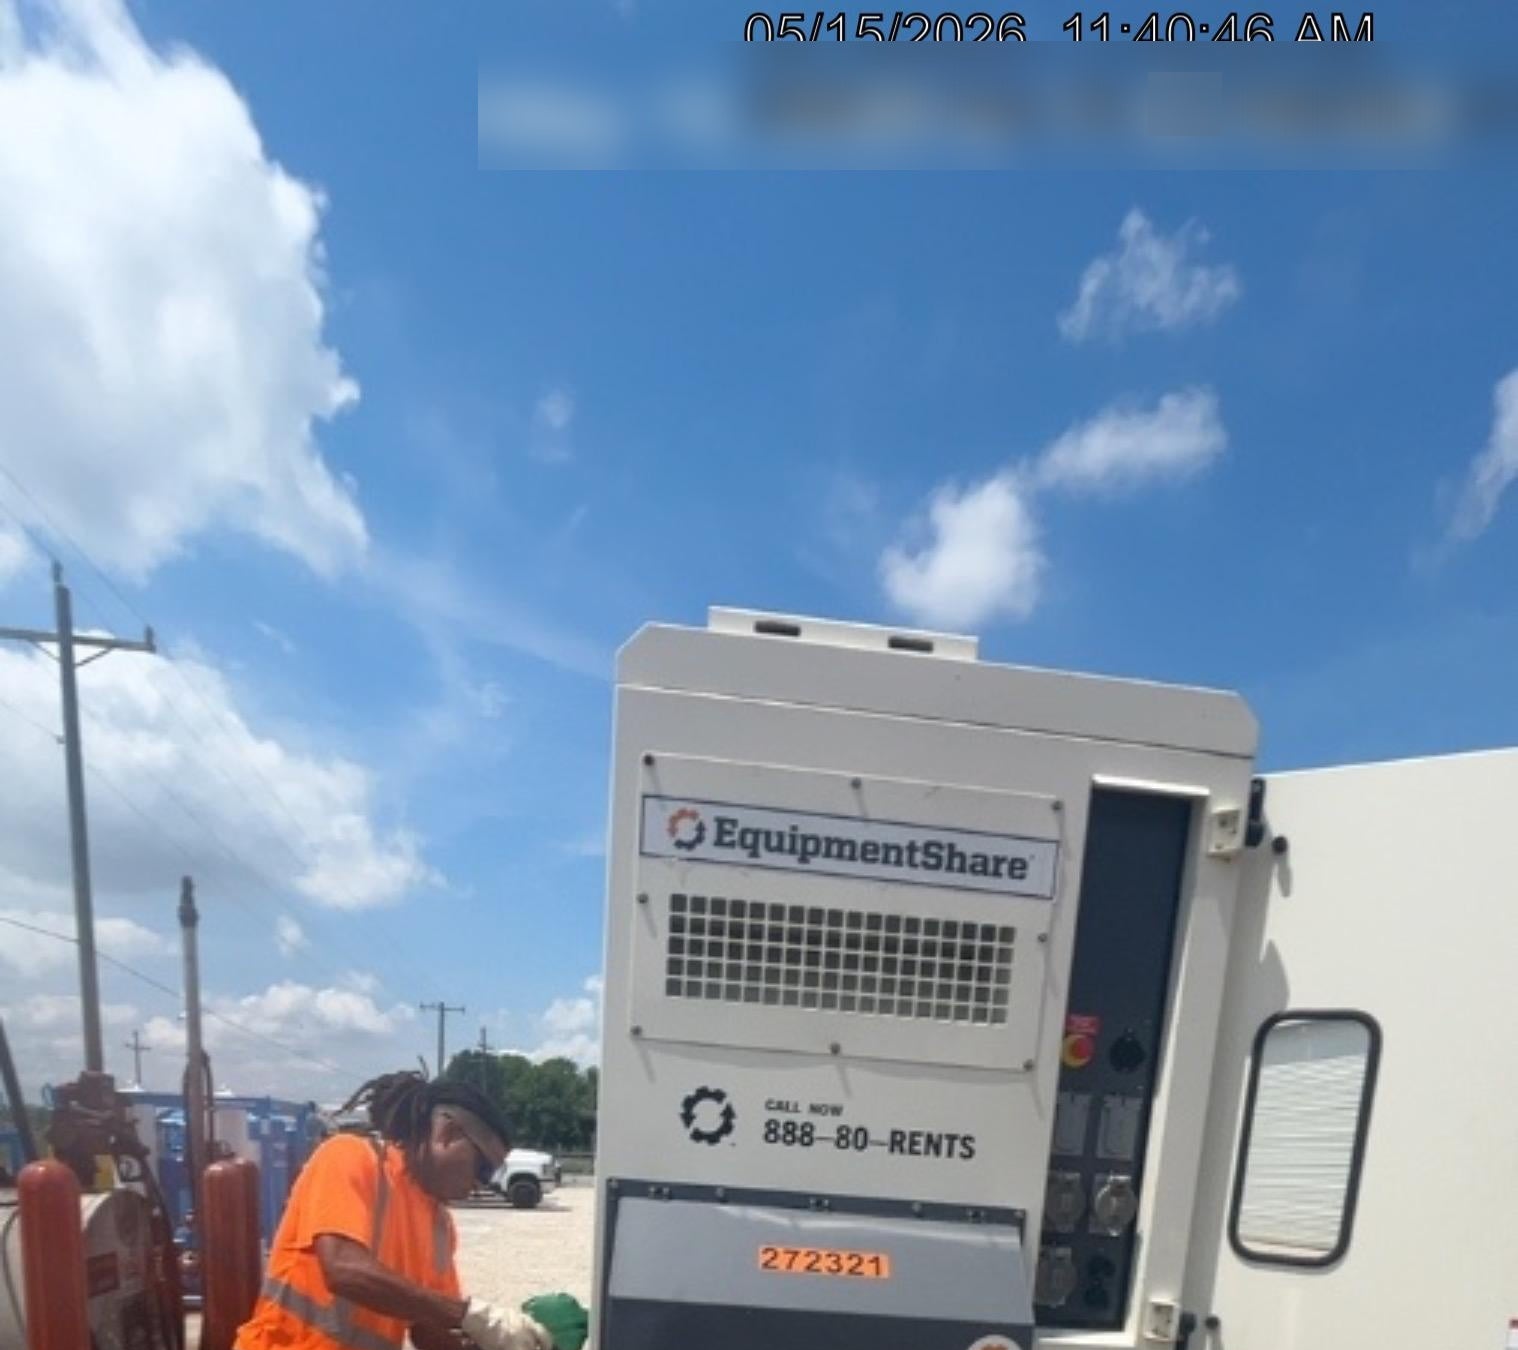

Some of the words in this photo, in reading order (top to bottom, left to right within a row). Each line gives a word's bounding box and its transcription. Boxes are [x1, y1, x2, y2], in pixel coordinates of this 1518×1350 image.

[713, 816, 1029, 880] EquipmentShare
[765, 1099, 801, 1113] CALL
[809, 1103, 844, 1117] NOW
[764, 1118, 976, 1160] 888-80-RENTS
[761, 1247, 881, 1276] 272321
